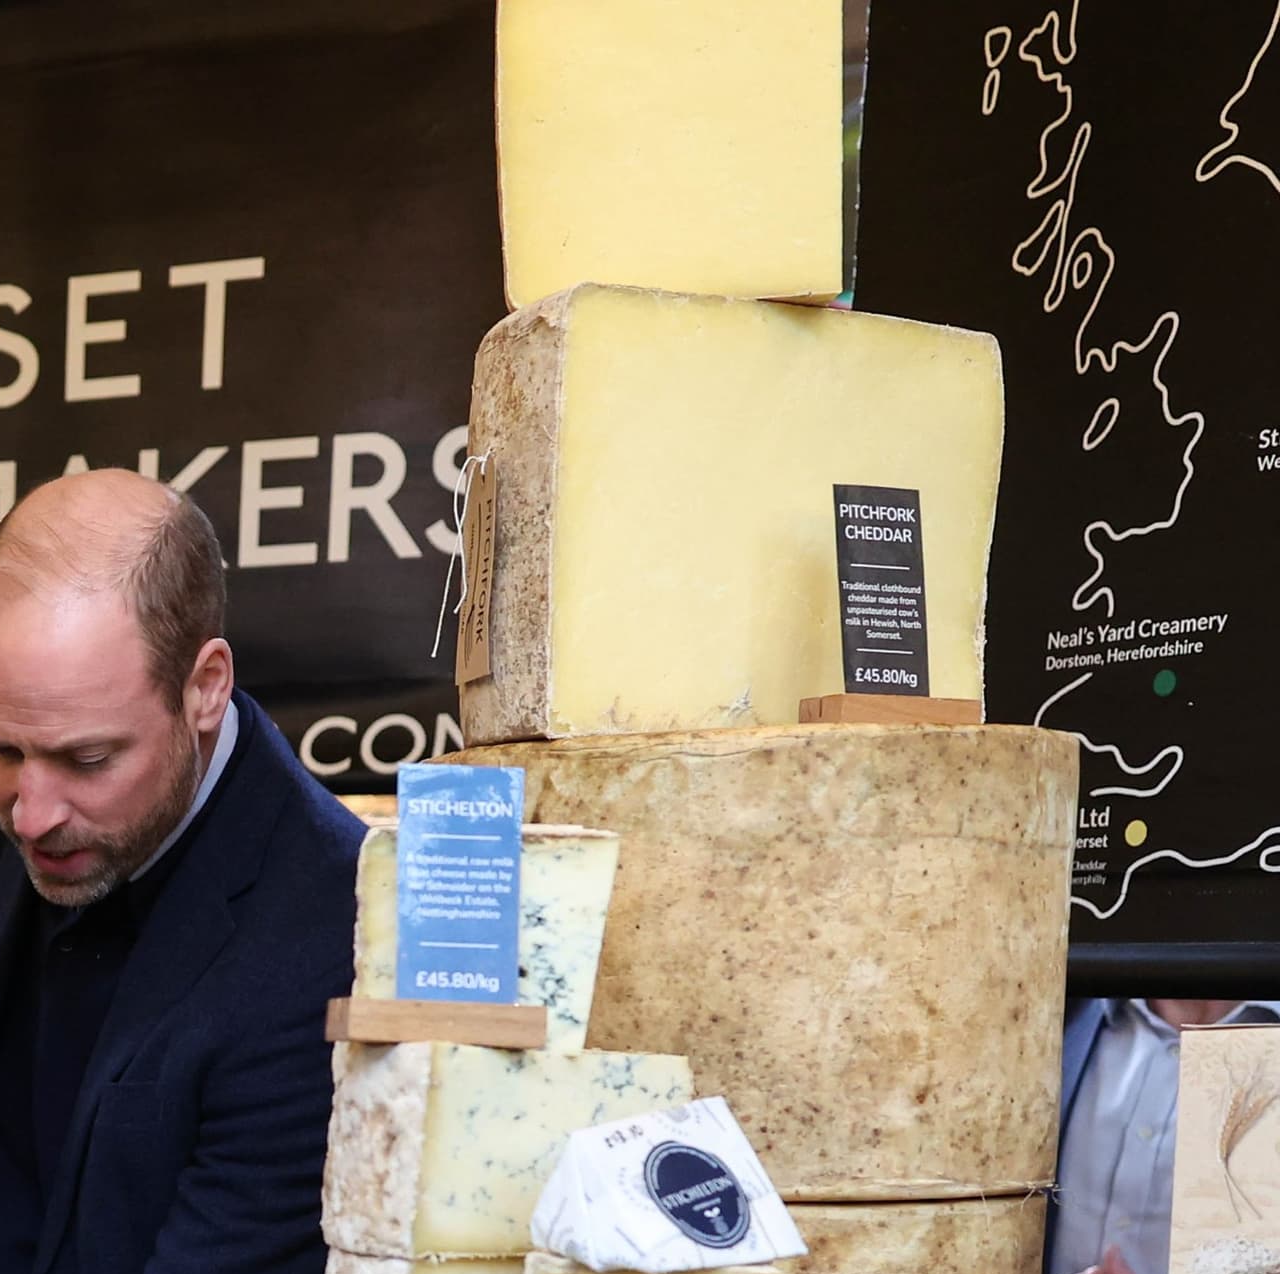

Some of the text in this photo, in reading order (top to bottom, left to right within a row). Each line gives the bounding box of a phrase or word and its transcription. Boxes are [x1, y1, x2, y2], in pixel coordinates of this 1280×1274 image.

[839, 503, 916, 523] PITCHFORK
[844, 525, 913, 543] CHEDDAR
[474, 498, 493, 643] PITCHFORK
[841, 580, 922, 594] Traditional clothbound
[847, 594, 917, 605] cheddar made from
[846, 606, 919, 617] unpasteurised cow's
[845, 617, 861, 626] milk
[862, 617, 870, 626] in
[900, 619, 922, 629] North
[1046, 612, 1229, 650] Neal's Yard Creamery
[1044, 638, 1205, 672] Dorstone, Herefordshire
[854, 667, 918, 687] £45.80/kg
[408, 800, 514, 818] STICHELTON
[1079, 805, 1111, 829] Ltd
[1075, 834, 1109, 849] erset
[491, 856, 514, 867] milk
[415, 970, 500, 992] £45.80/kg
